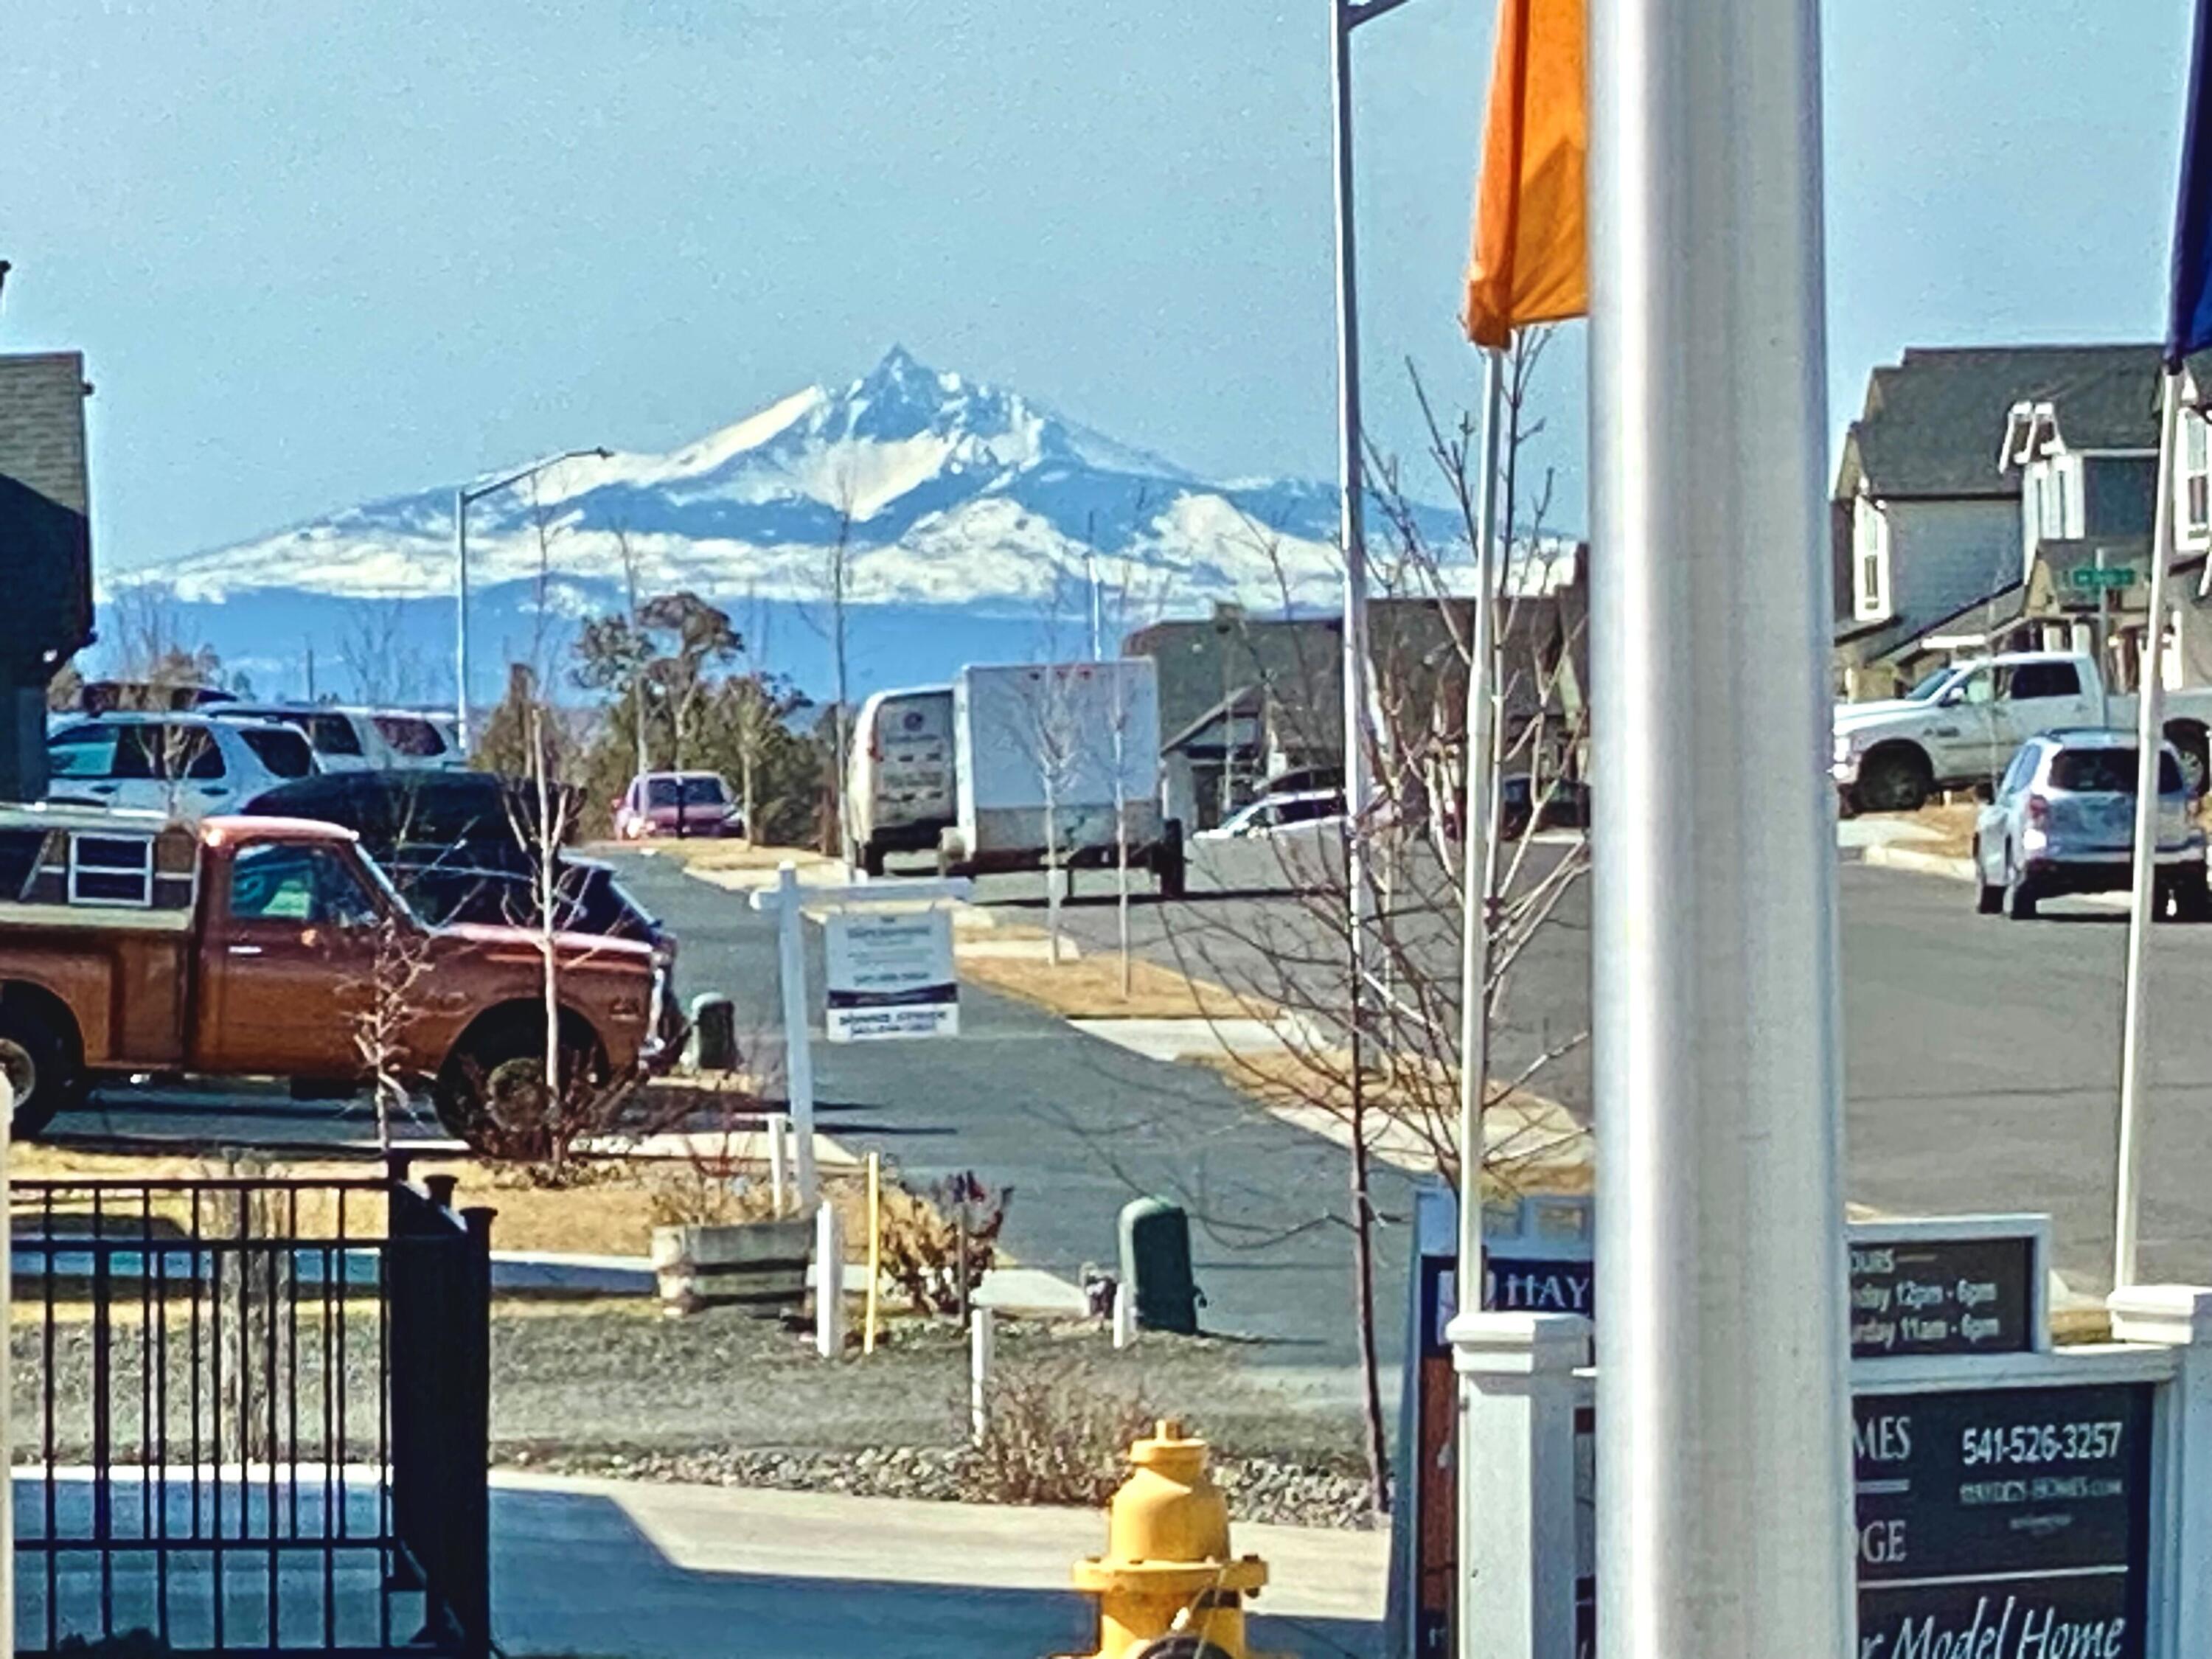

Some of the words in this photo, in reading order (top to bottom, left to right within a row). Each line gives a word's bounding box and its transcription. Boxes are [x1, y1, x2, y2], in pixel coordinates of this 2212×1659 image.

[1961, 1420, 2124, 1466] 541-526-3257
[1890, 1595, 2017, 1659] Model
[2015, 1605, 2126, 1659] Home
